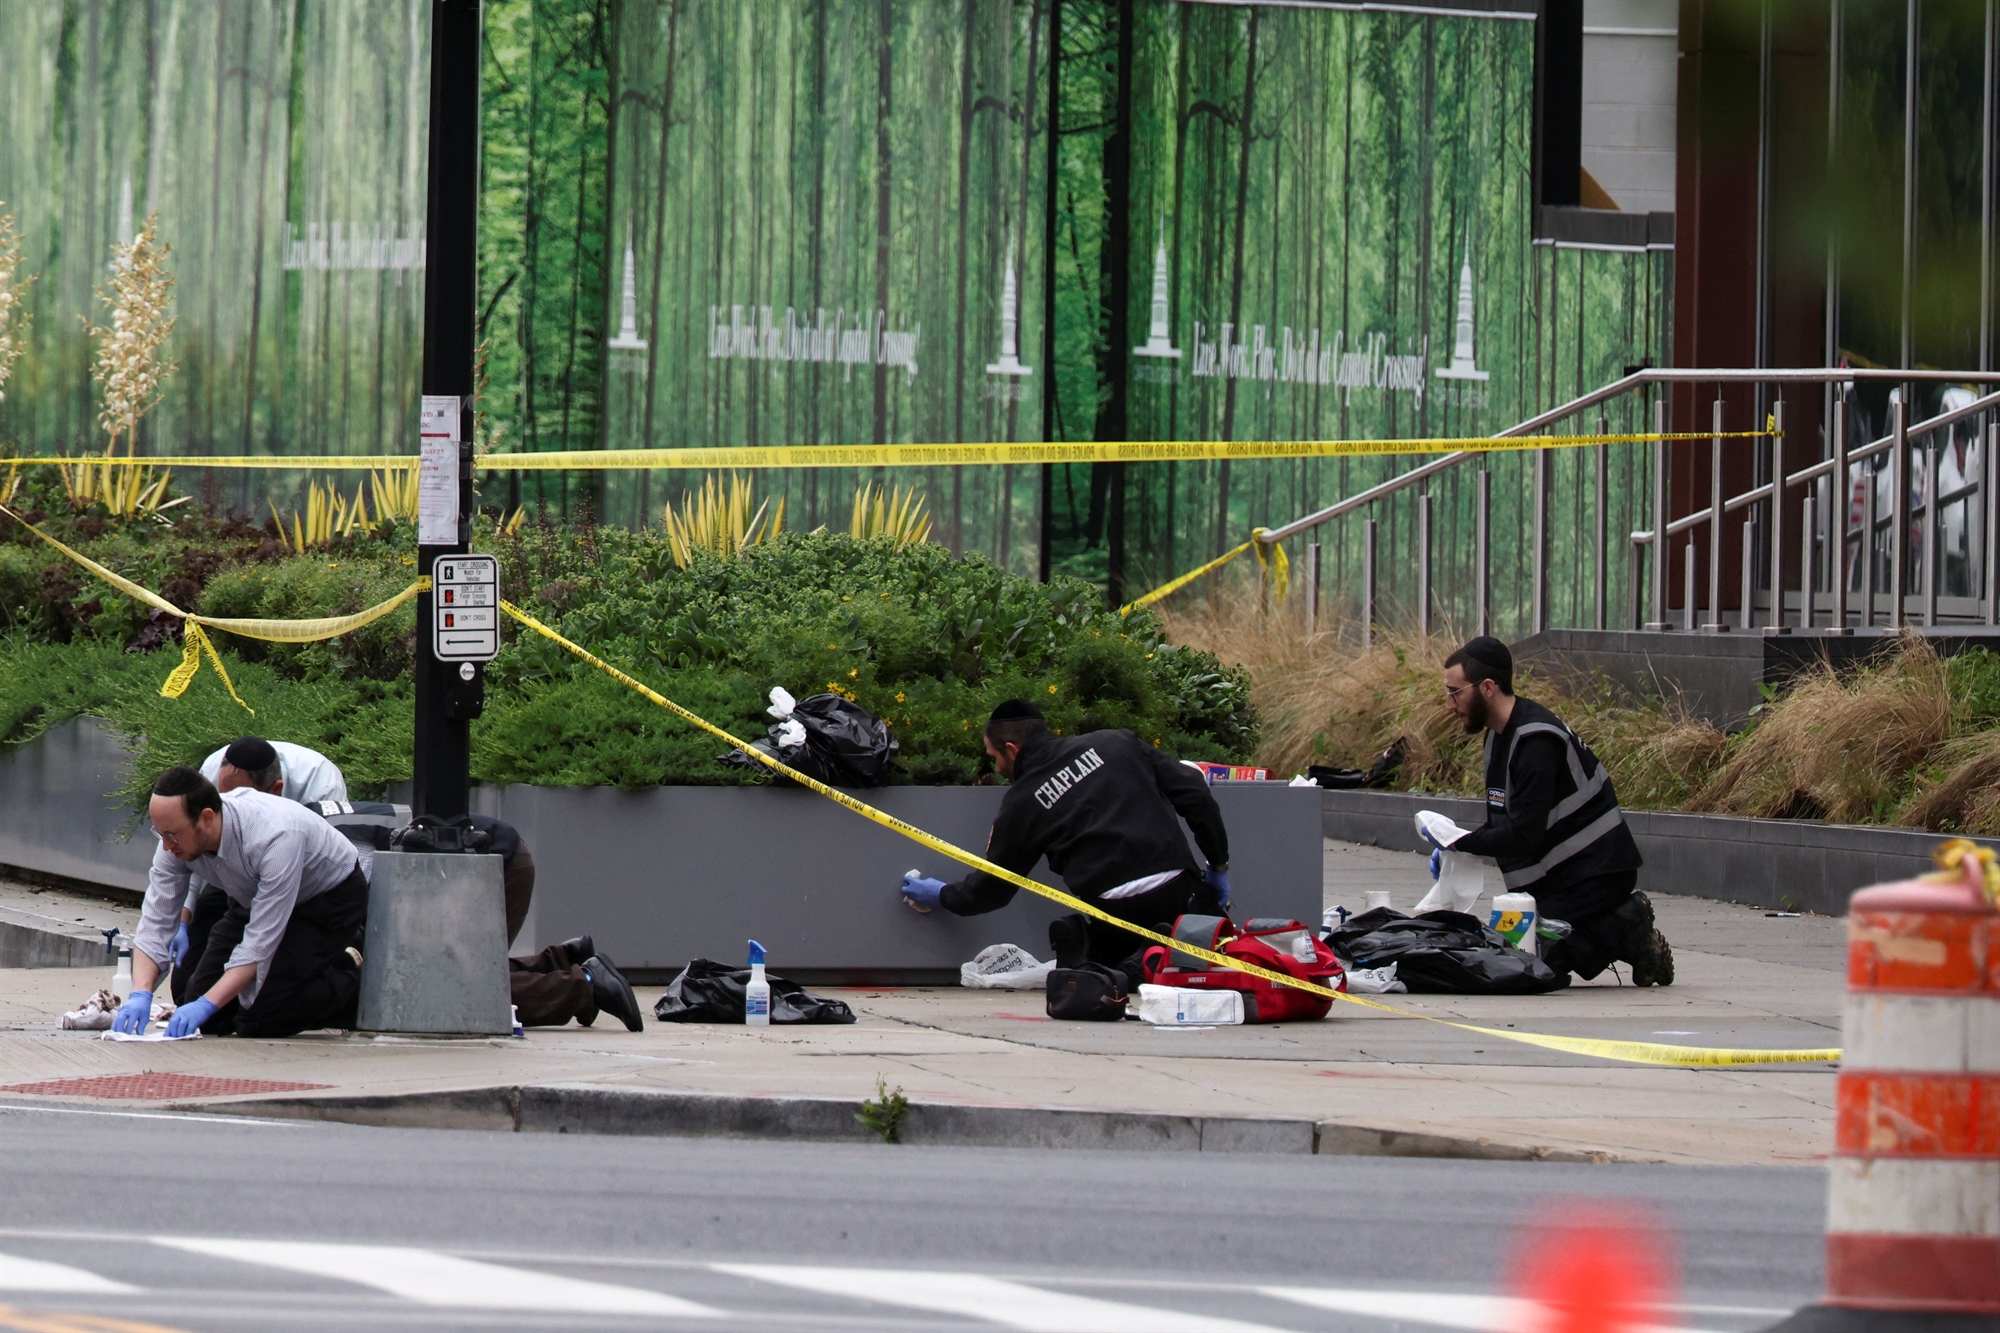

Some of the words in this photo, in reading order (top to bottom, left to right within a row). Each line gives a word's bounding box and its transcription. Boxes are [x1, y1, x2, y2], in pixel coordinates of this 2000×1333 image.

[836, 306, 873, 383] Capitol
[1192, 320, 1220, 378] Live.
[1252, 323, 1277, 401] Play.
[1281, 326, 1297, 382] Do
[1298, 331, 1305, 383] it
[1306, 328, 1320, 385] all
[1319, 343, 1331, 386] at
[1333, 329, 1373, 407] Capitol
[1374, 331, 1428, 412] Crossing!
[1034, 747, 1105, 810] CHAPLAIN
